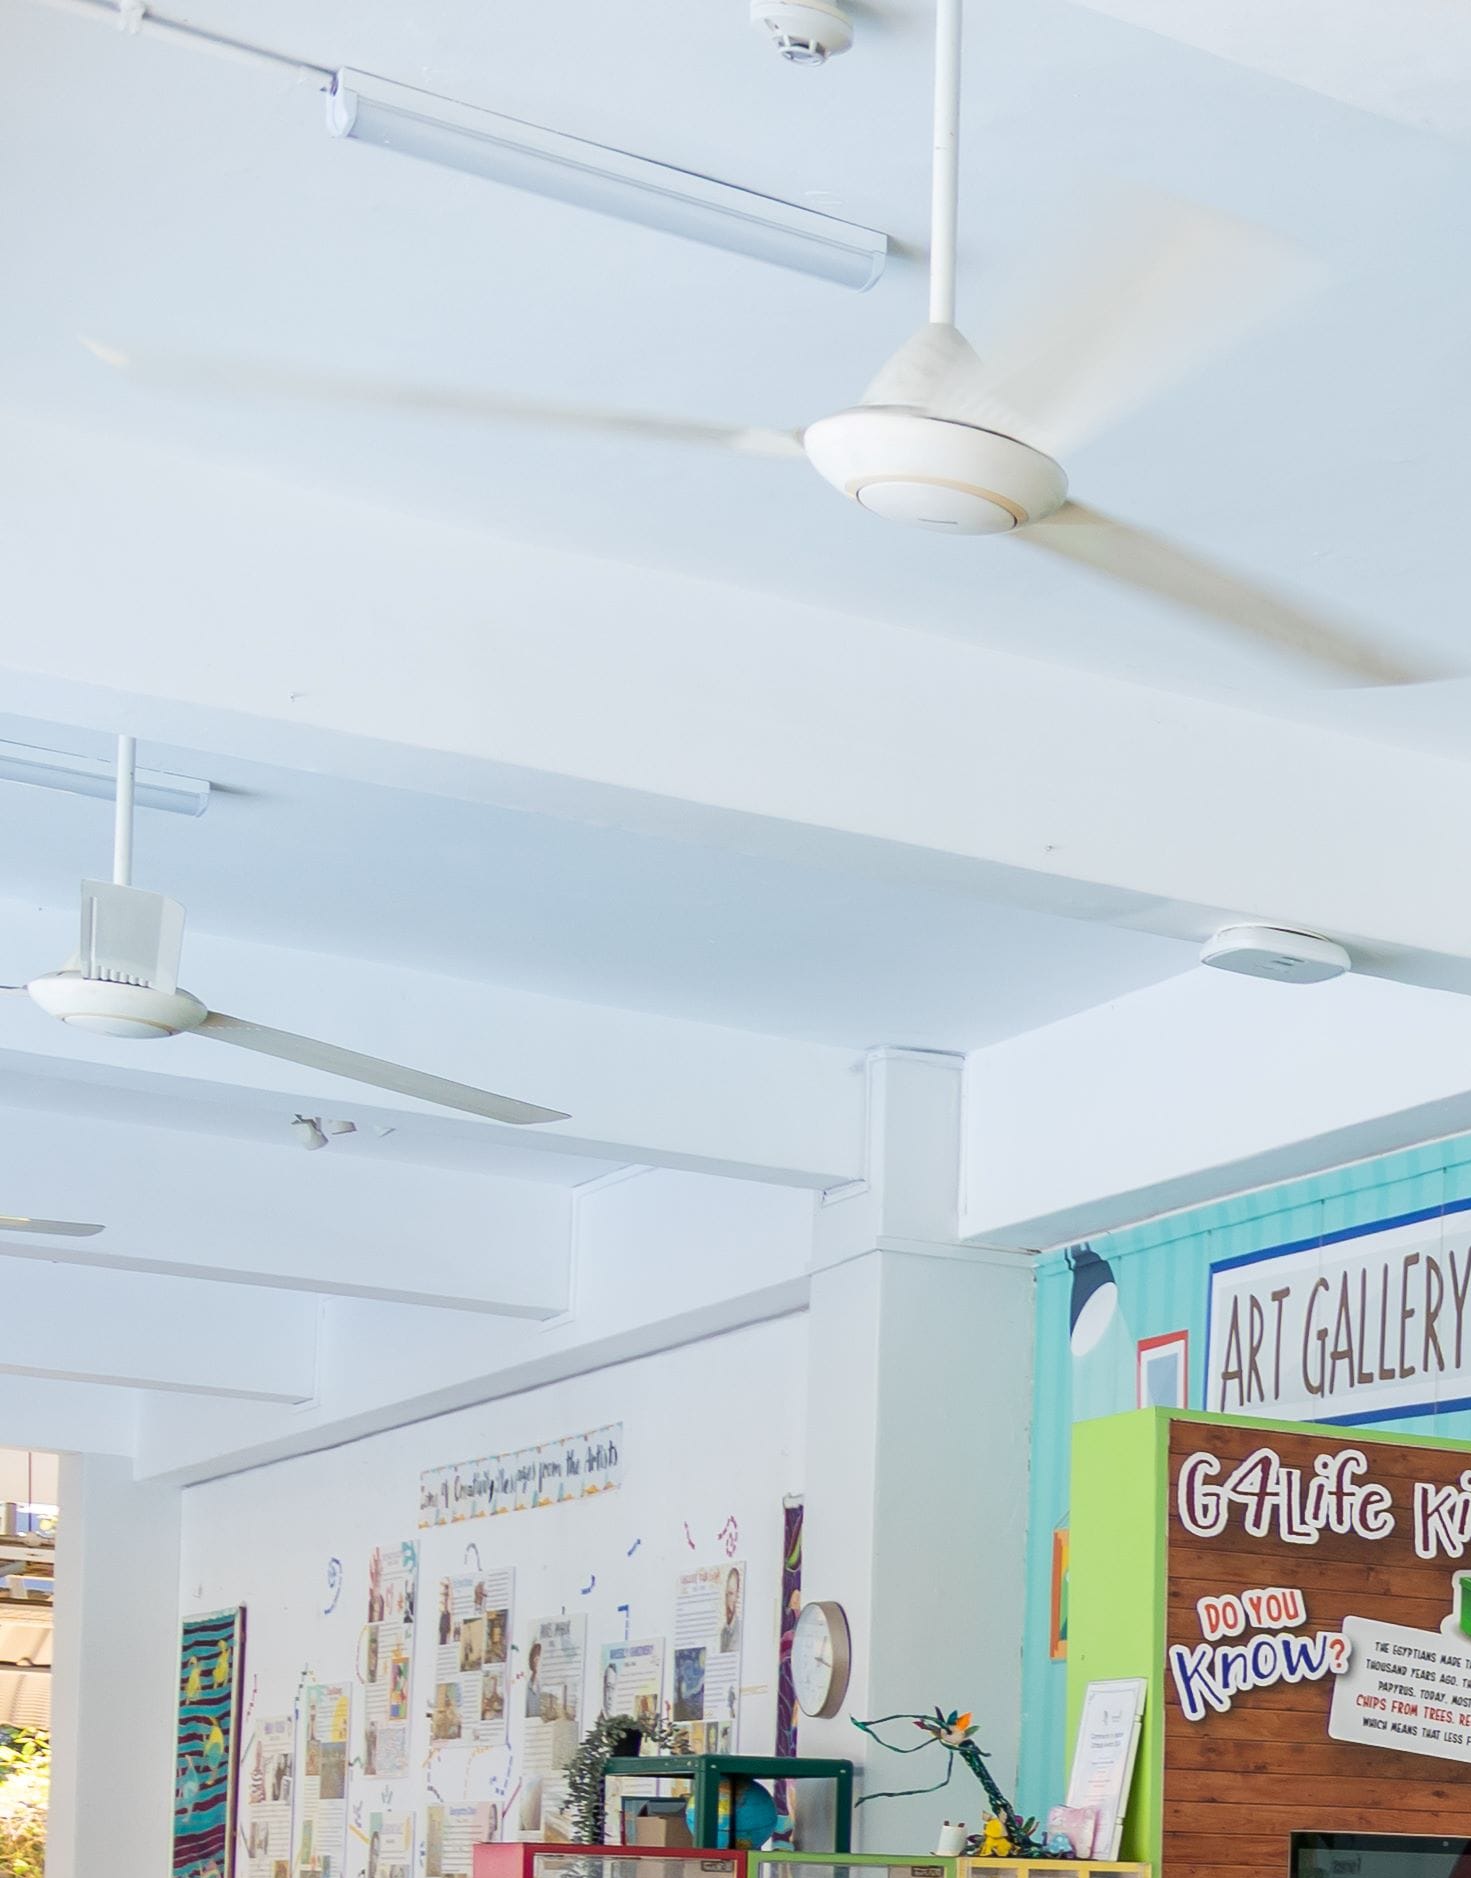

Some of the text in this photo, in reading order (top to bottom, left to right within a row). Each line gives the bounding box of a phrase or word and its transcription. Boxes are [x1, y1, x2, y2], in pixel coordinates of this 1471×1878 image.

[1220, 1286, 1291, 1412] ART
[1201, 1589, 1303, 1641] DO YOU
[1376, 1642, 1389, 1653] THE
[1393, 1645, 1436, 1662] EGYPTIANS
[1441, 1656, 1461, 1667] MADE
